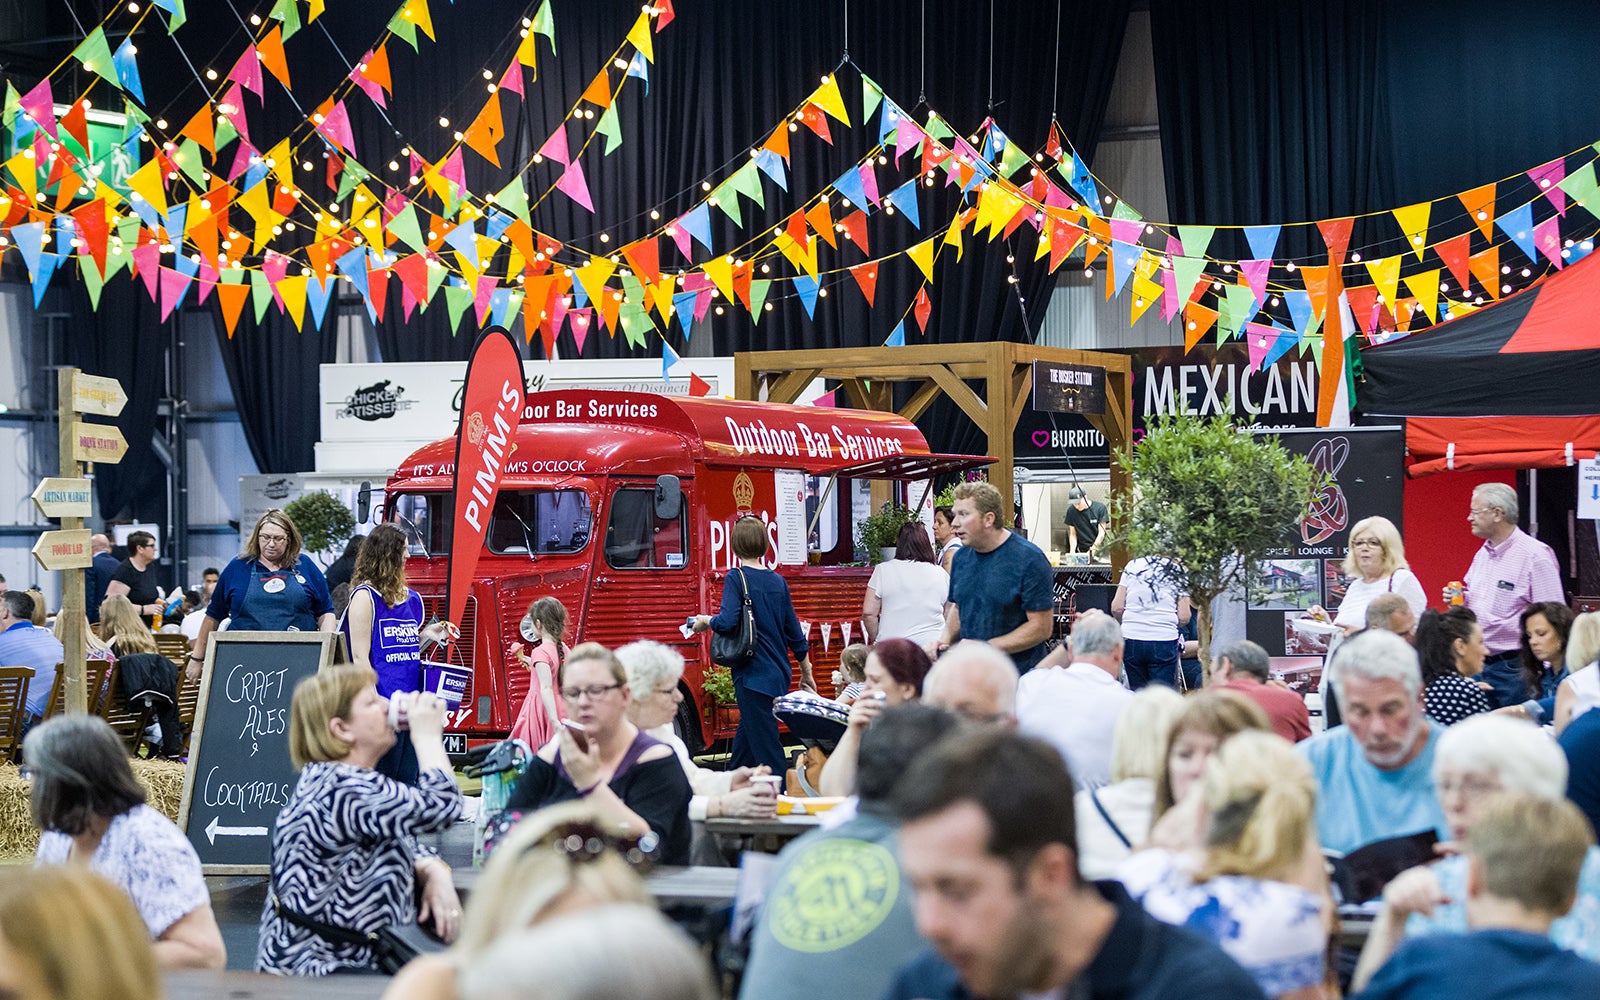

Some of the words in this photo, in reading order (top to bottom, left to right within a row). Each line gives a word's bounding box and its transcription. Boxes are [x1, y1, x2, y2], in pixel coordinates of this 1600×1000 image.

[1050, 368, 1059, 383] THE
[1074, 371, 1093, 387] STATION
[345, 389, 402, 406] CHICKEN
[1143, 361, 1315, 417] MEXICAN
[335, 401, 413, 420] ROTISSERIE
[556, 400, 582, 418] Bar
[588, 400, 658, 418] Services
[97, 438, 118, 451] STATION
[725, 416, 799, 457] Outdoor
[797, 422, 833, 459] Bar
[831, 425, 903, 460] Services
[464, 379, 520, 533] PIMM'S
[413, 465, 434, 476] IT'S
[532, 460, 587, 473] O'CLOCK
[43, 491, 67, 503] ARTISAN
[73, 543, 84, 555] LAB
[1298, 547, 1334, 555] LOUNGE
[1053, 582, 1070, 600] LIFE
[384, 626, 419, 638] ERSKIN
[386, 652, 411, 663] OFFICIAL
[225, 664, 289, 705] CRAFT
[239, 704, 286, 741] ALES
[204, 766, 290, 813] COCKTAILS
